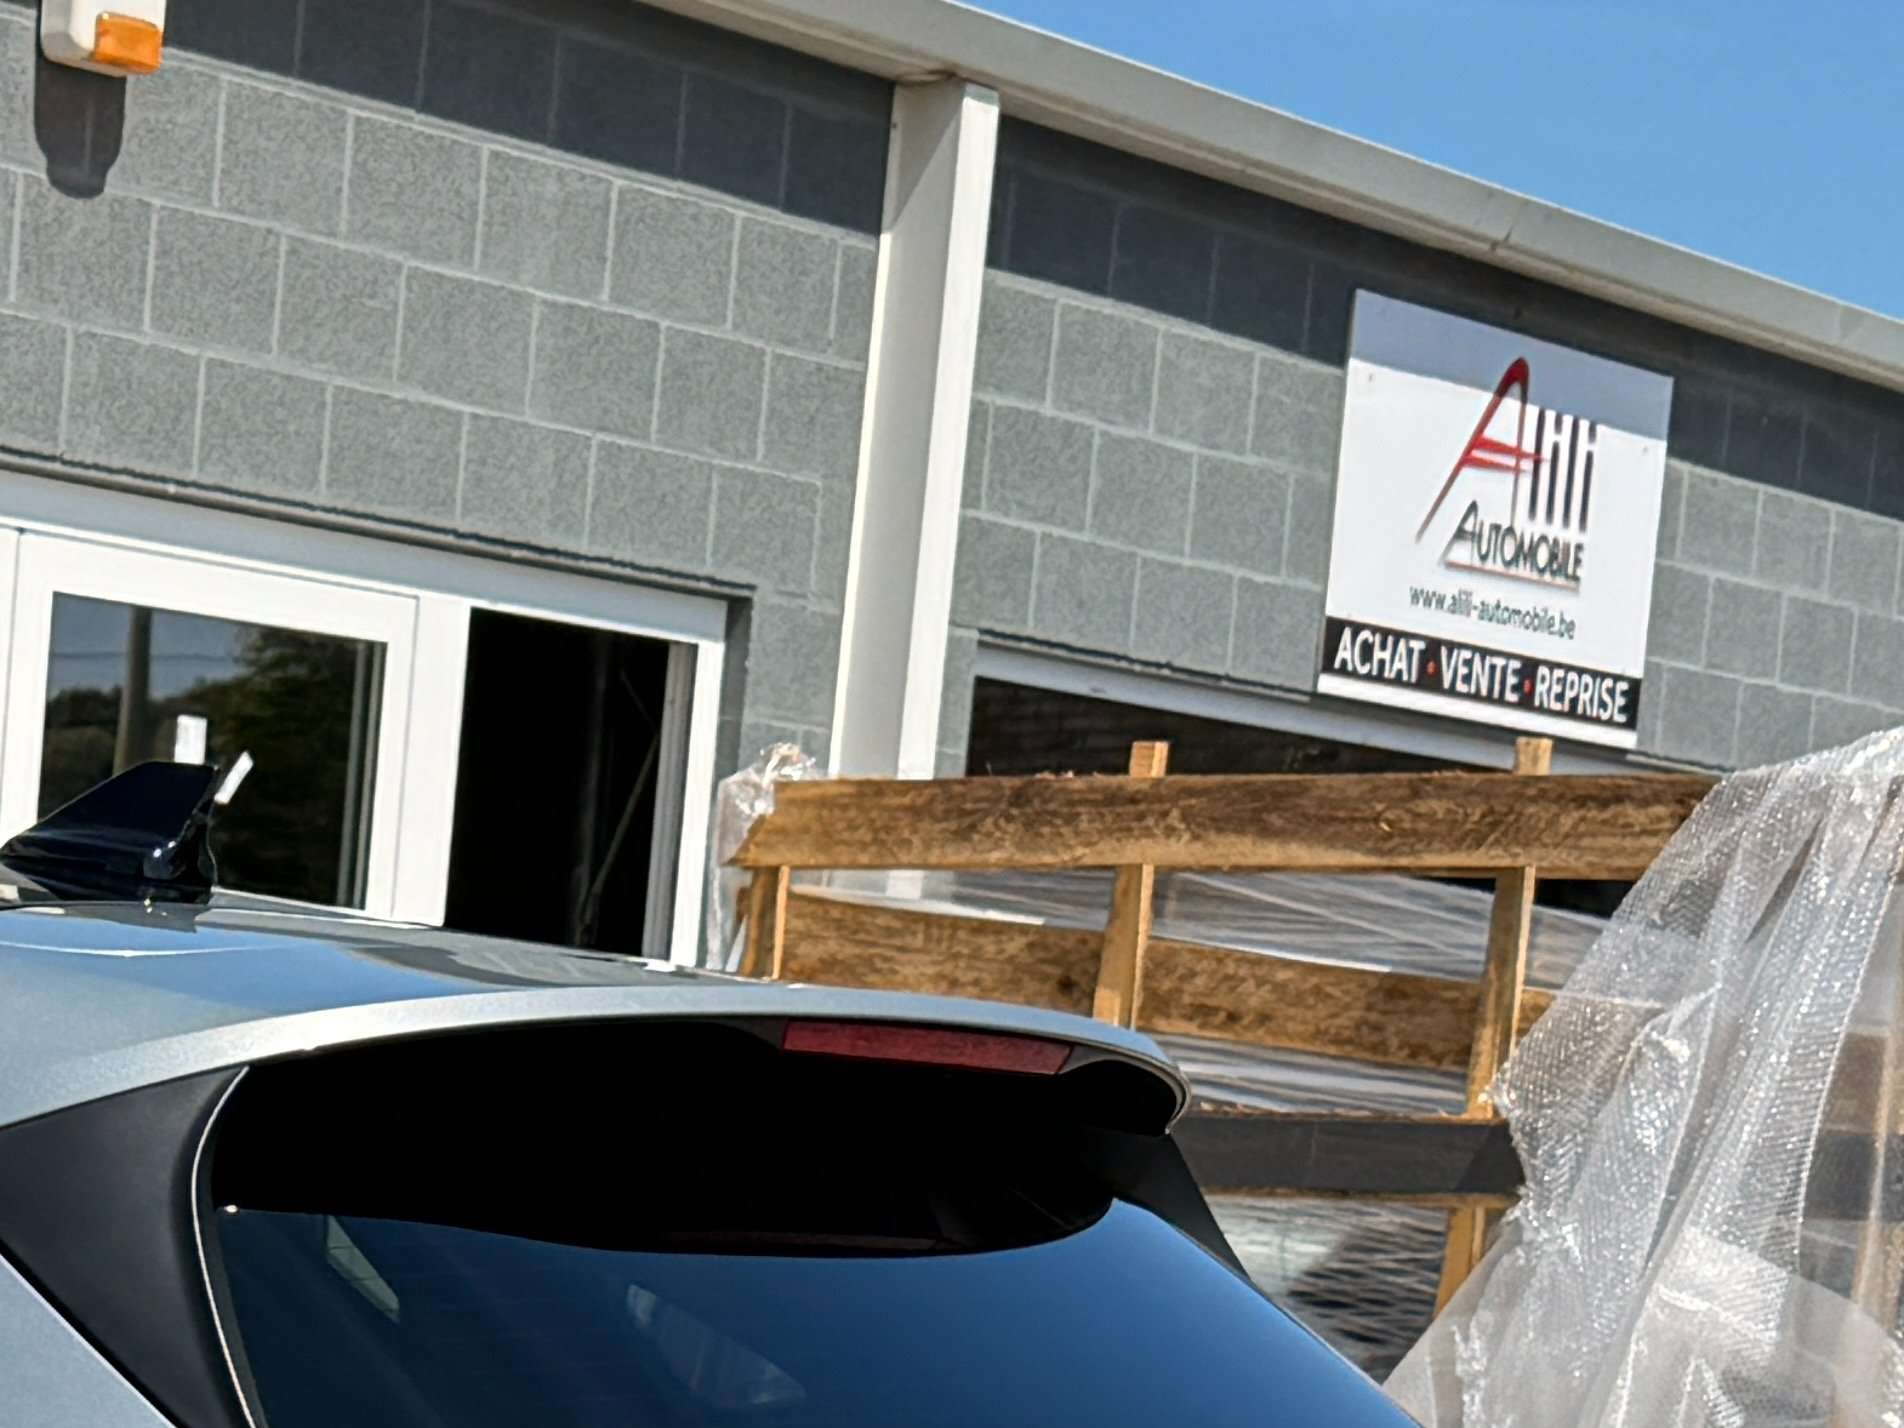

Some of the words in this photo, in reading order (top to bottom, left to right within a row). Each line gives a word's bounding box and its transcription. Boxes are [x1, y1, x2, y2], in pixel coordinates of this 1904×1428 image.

[1333, 626, 1426, 684] ACHAT
[1439, 645, 1523, 703] VENTE
[1534, 666, 1629, 723] REPRISE
